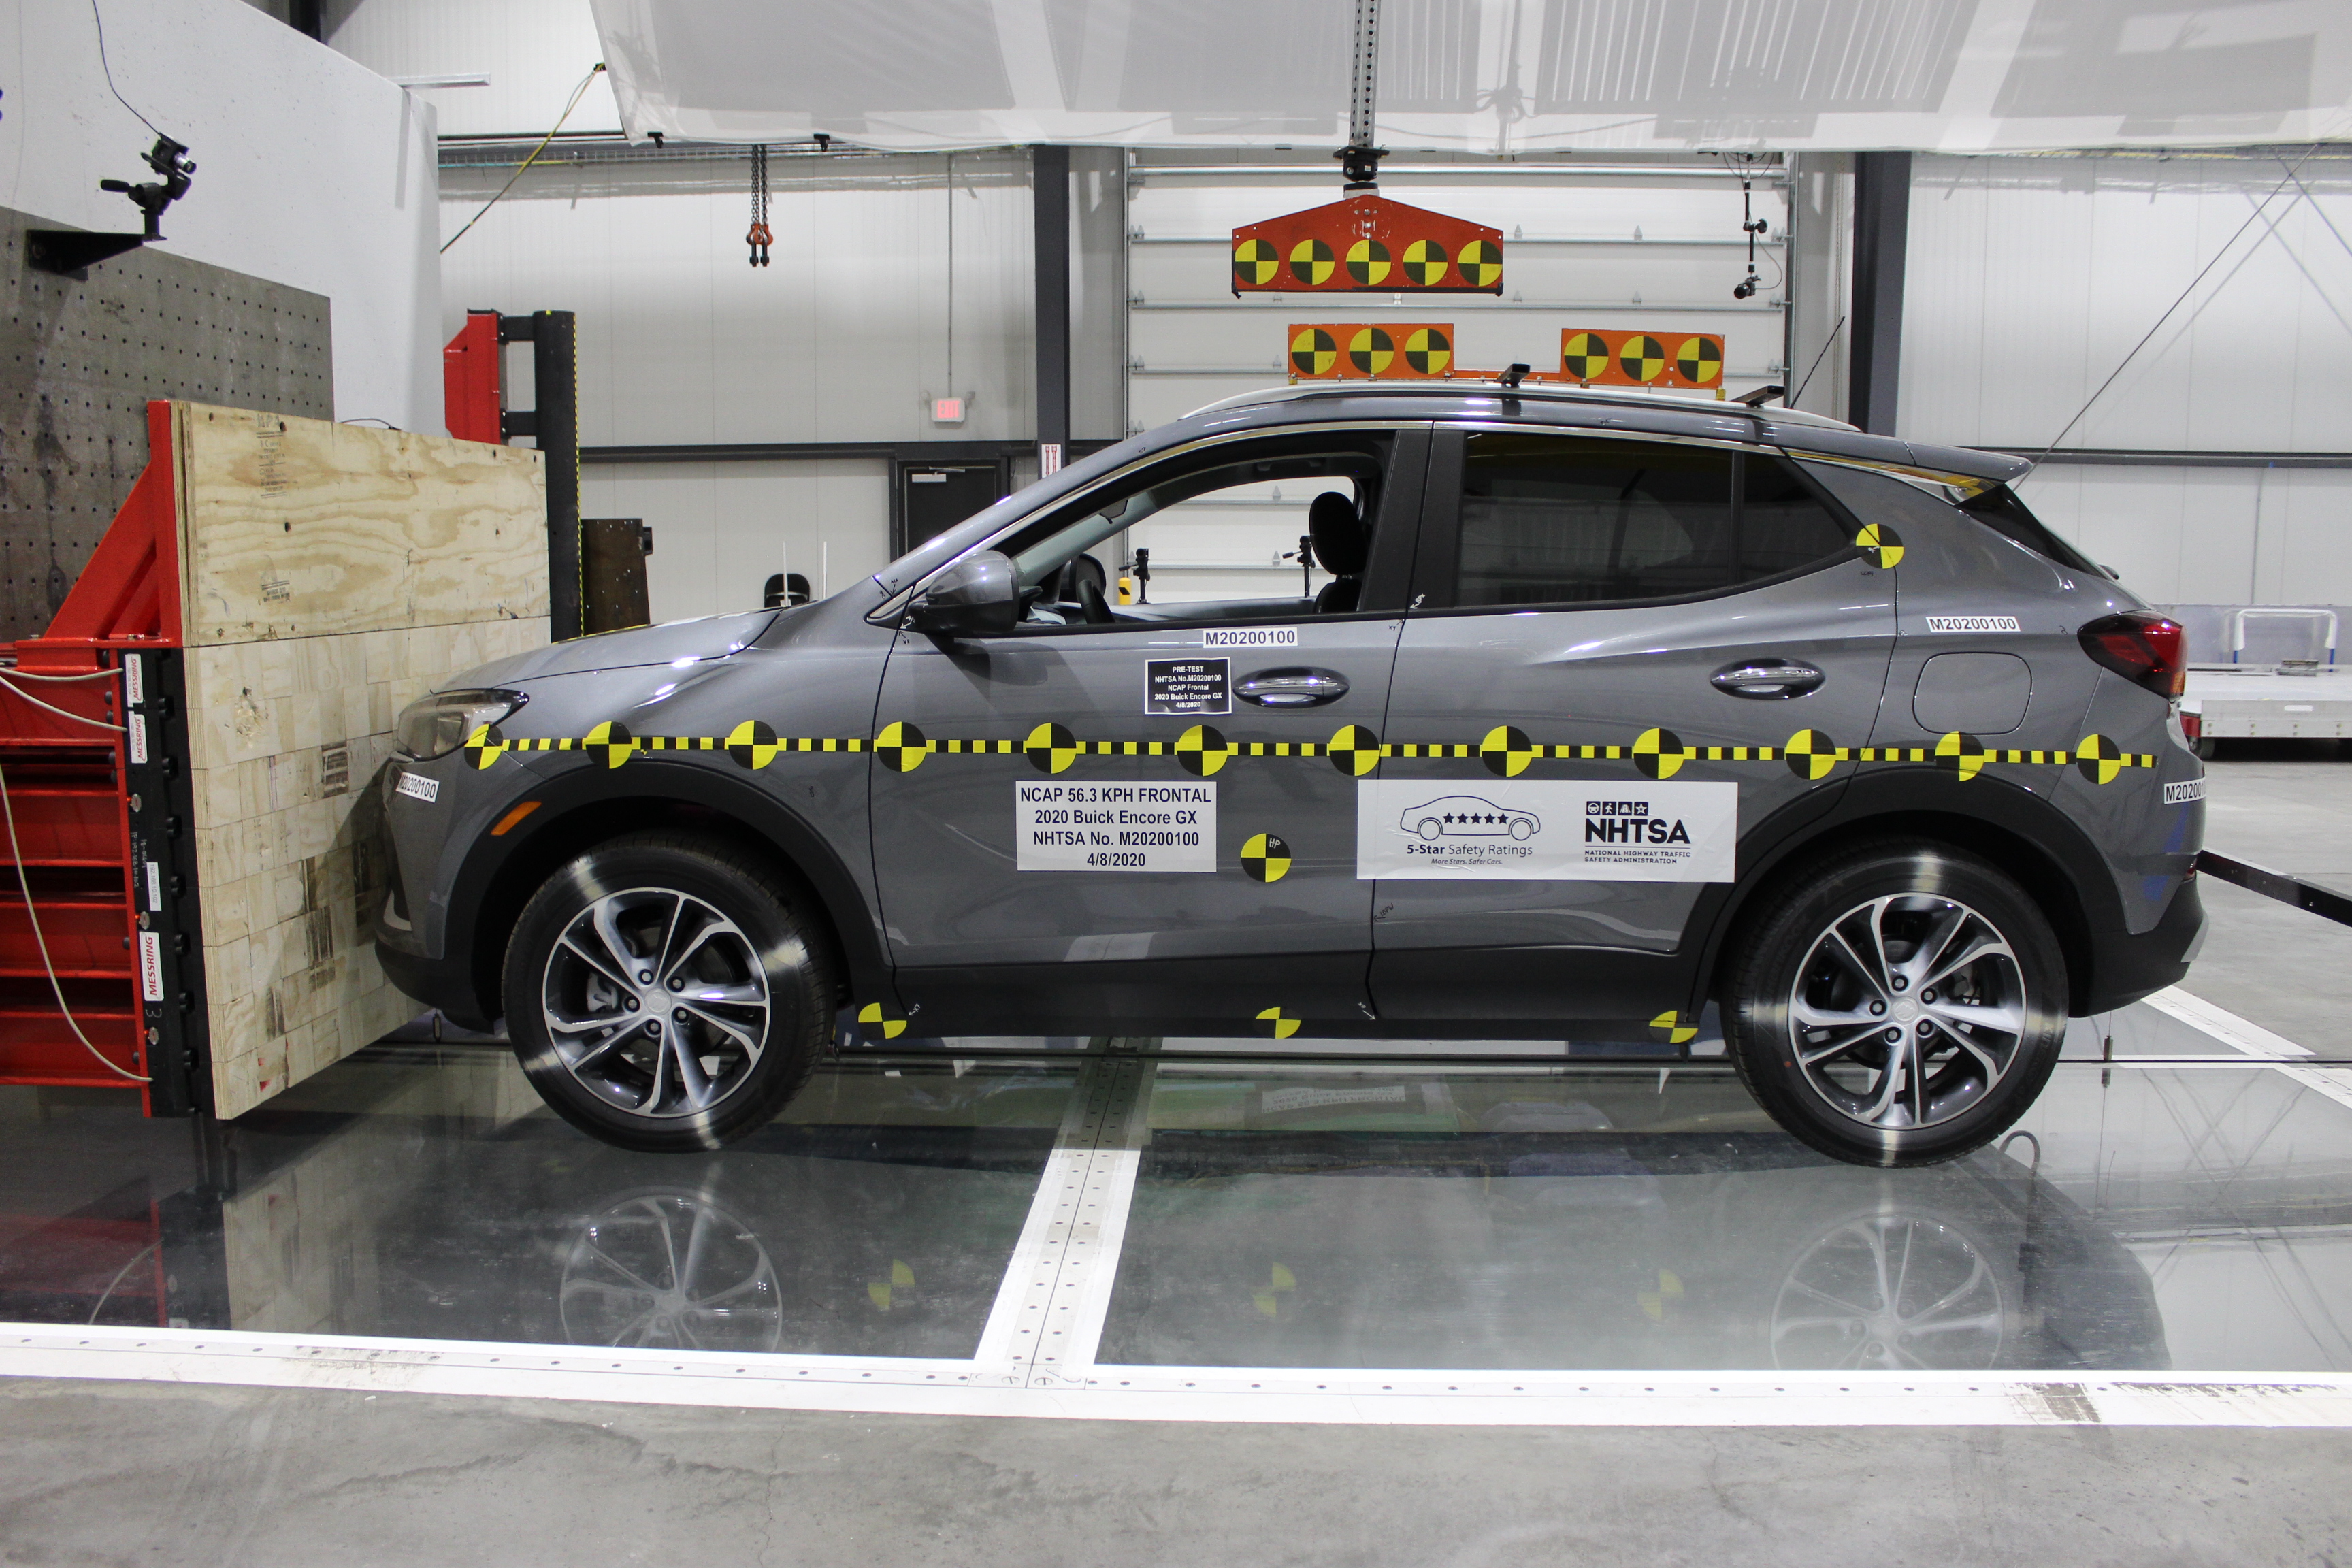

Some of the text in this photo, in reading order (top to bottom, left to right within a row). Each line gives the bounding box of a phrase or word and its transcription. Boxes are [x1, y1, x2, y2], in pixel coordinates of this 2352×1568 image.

[938, 400, 960, 418] EXIT
[1929, 618, 2016, 630] M20200100
[1205, 630, 1295, 645] M20200100
[1020, 787, 1211, 802] NCAP 56.3 KPH FRONTAL
[1034, 809, 1197, 824] 2020 Buick Encore GX
[1033, 831, 1199, 845] NHTSA No. M20200100
[1585, 818, 1691, 844] NHTSA
[1407, 844, 1533, 858] 5-Star Safety Ratings
[1087, 853, 1146, 866] 4/8/2020
[150, 864, 158, 904] 192.168.10.102
[145, 936, 157, 996] MESSRING
